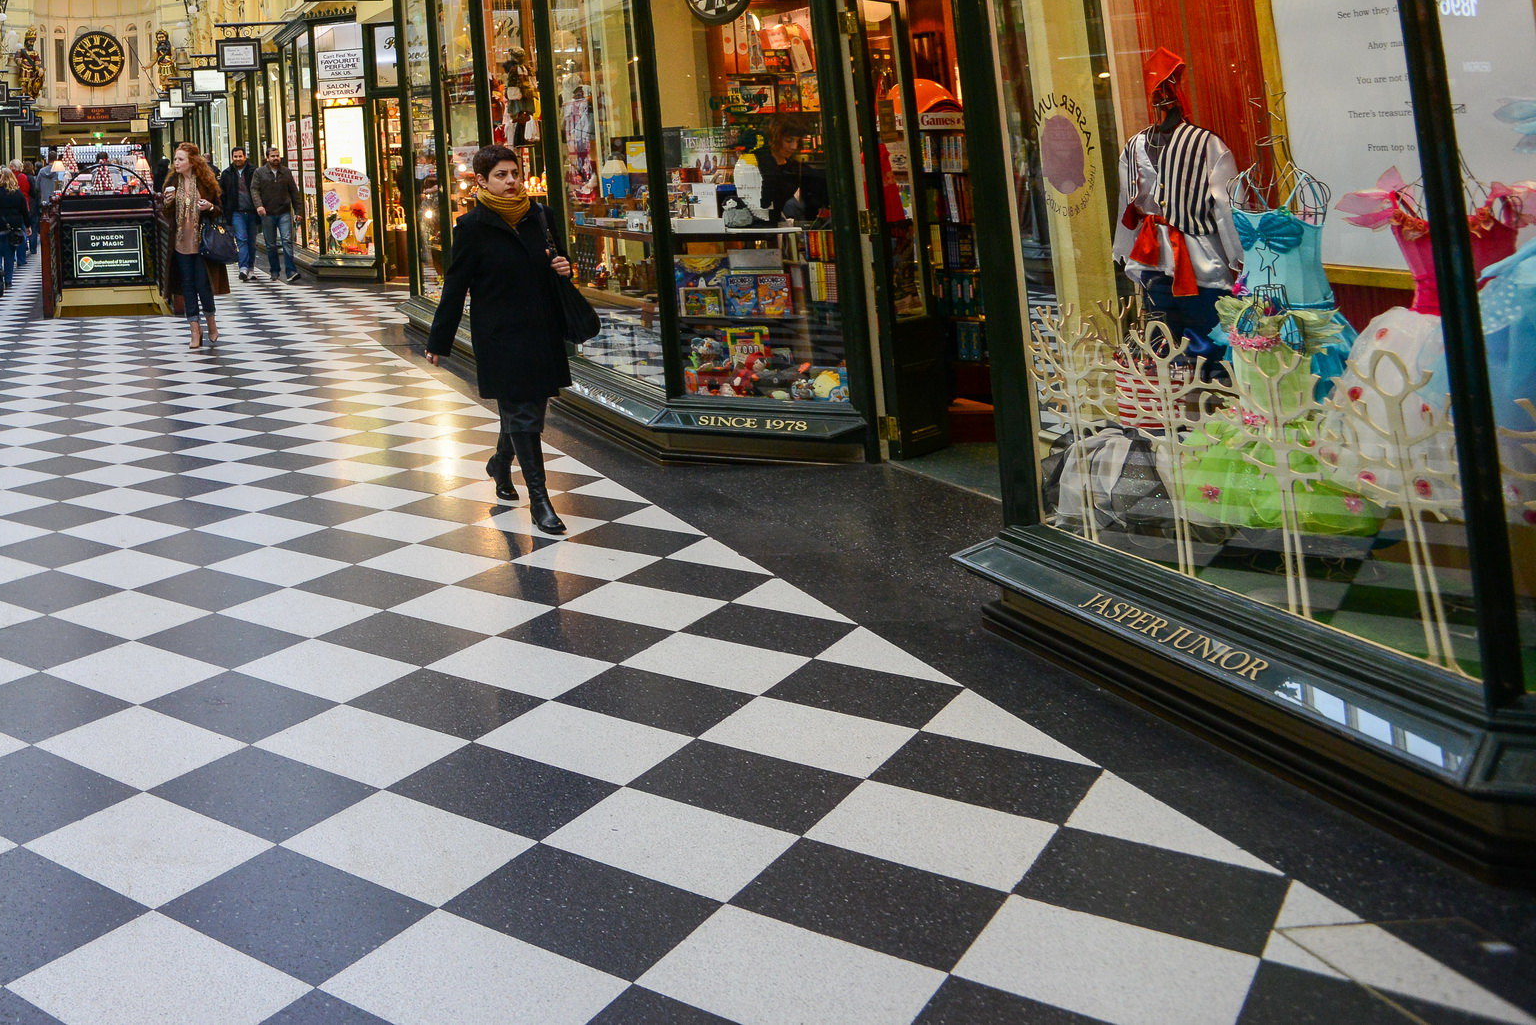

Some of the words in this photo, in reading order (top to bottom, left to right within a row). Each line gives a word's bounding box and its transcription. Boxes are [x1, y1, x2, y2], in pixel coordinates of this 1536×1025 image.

[1337, 11, 1351, 19] See
[1353, 7, 1370, 17] how
[1372, 5, 1390, 16] they
[1367, 41, 1387, 51] Ahoy
[320, 57, 361, 65] FAVOURITE
[324, 62, 357, 70] PERFUME
[1356, 76, 1372, 85] You
[1374, 75, 1388, 83] are
[1388, 74, 1403, 82] not
[1378, 108, 1412, 117] treasure
[920, 114, 956, 126] Games
[1367, 143, 1389, 152] From
[1391, 143, 1405, 153] top
[1406, 143, 1416, 152] to
[328, 171, 364, 181] JEWELLERY
[334, 167, 358, 175] GIANT
[735, 345, 759, 354] WOOD
[698, 415, 758, 429] SINCE
[765, 418, 808, 432] 1978
[1077, 592, 1169, 638] JASPER
[1158, 625, 1269, 681] JUNIOR
